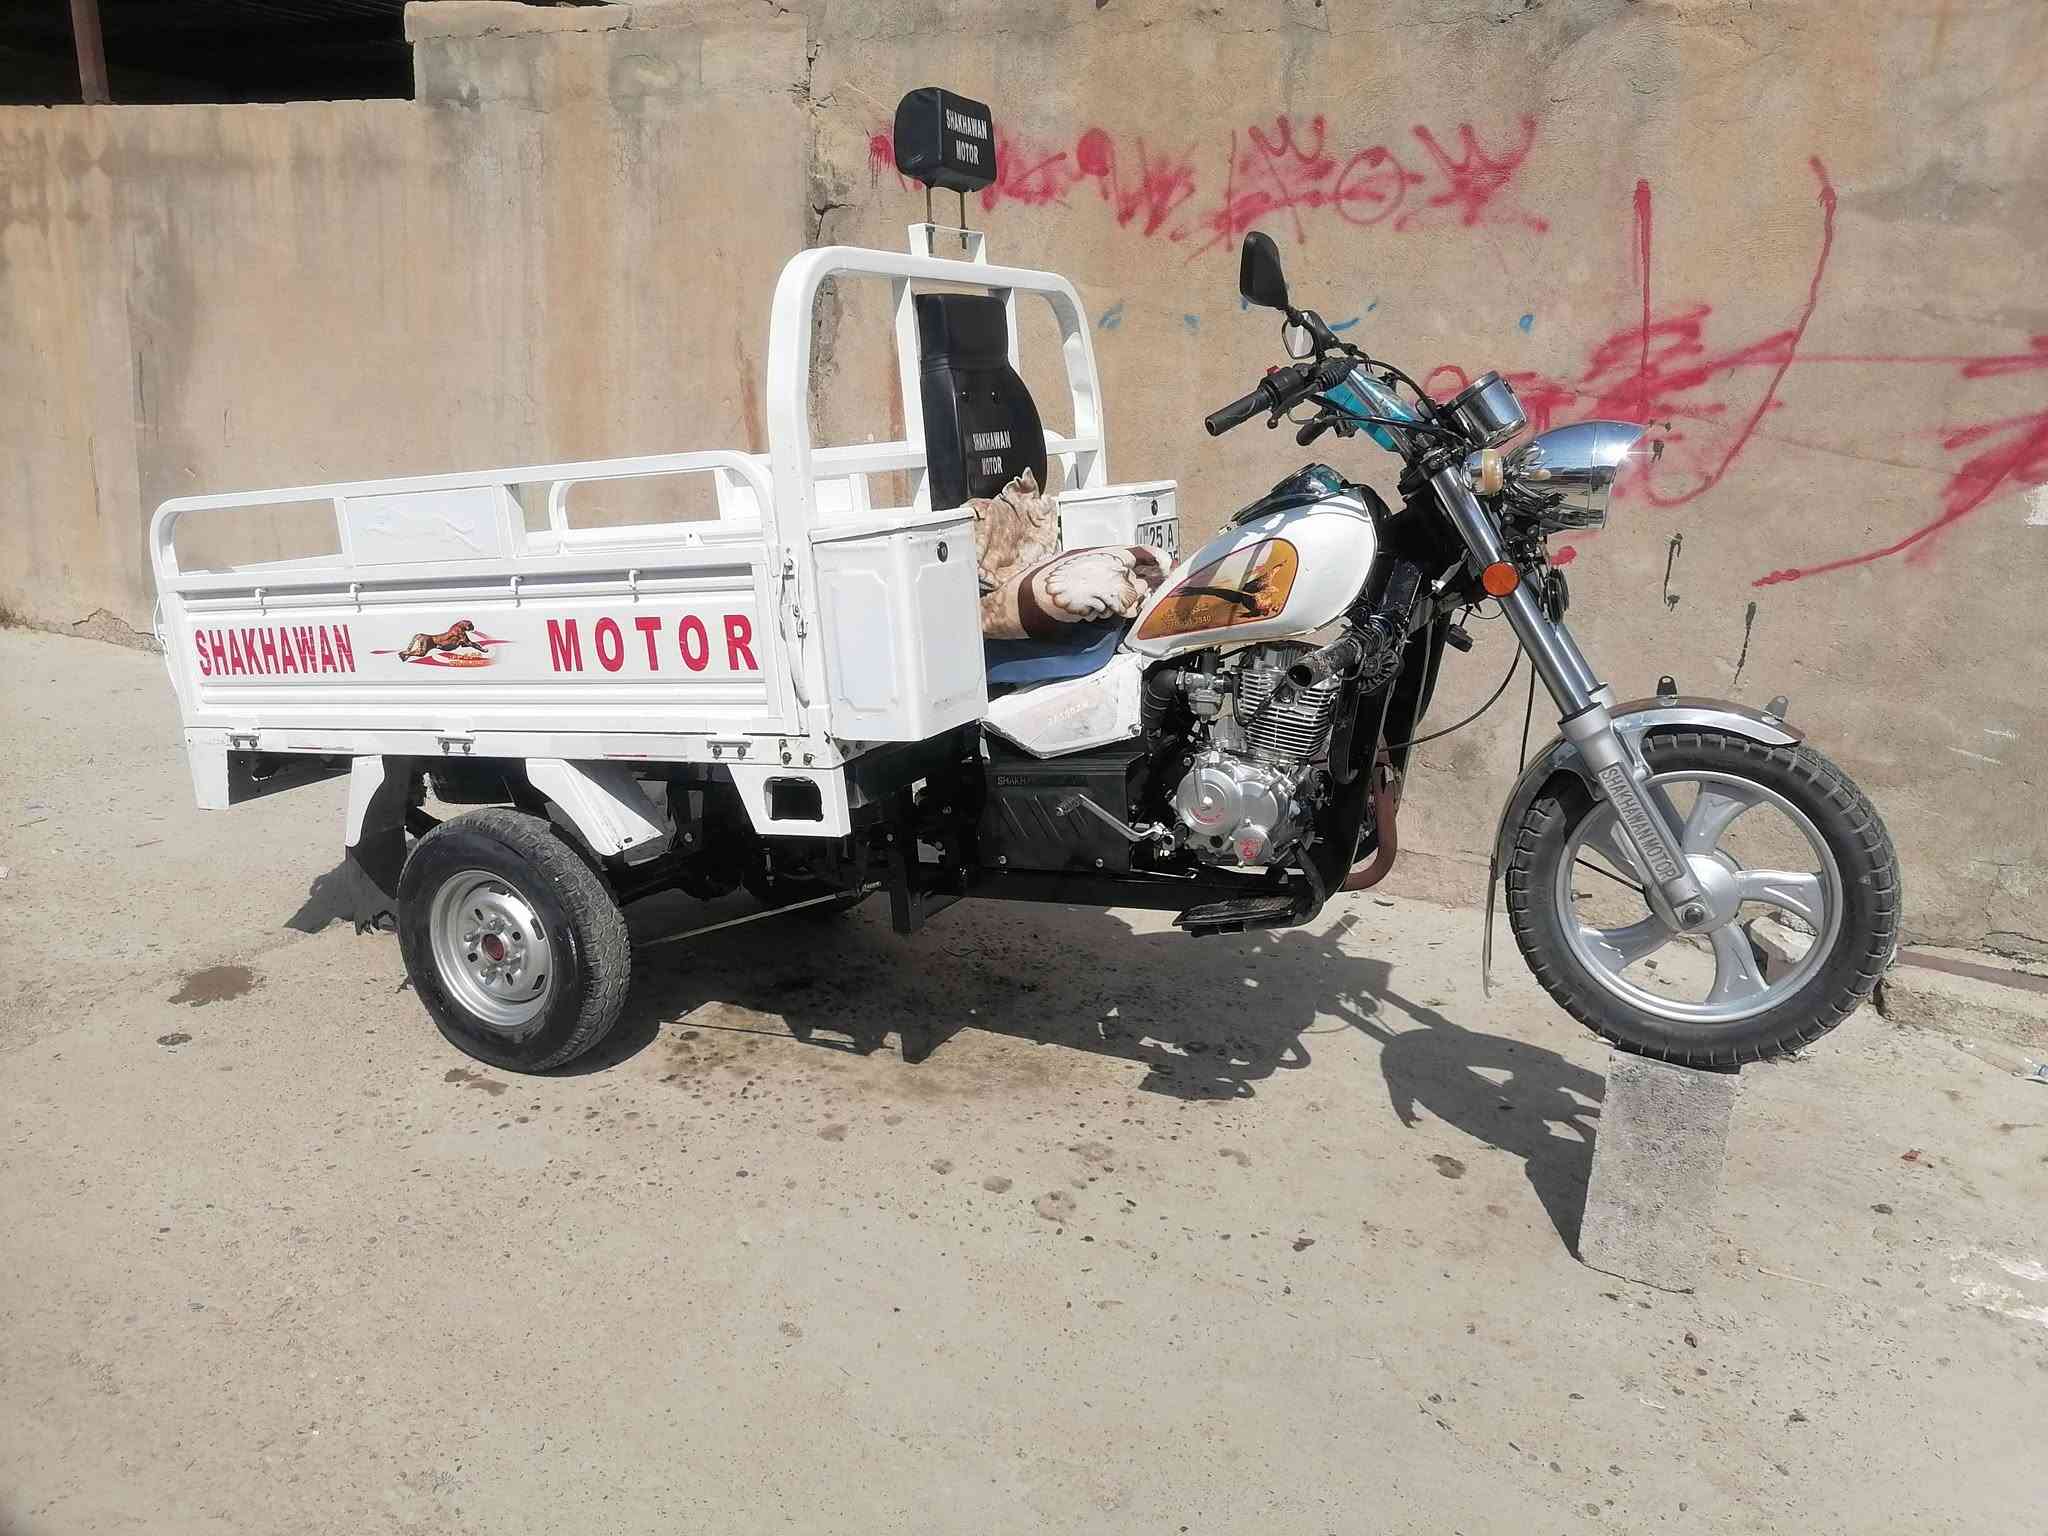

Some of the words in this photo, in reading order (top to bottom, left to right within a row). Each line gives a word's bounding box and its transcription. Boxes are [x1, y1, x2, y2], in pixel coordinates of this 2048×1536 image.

[946, 109, 988, 139] SHAKHAWAN
[955, 140, 979, 165] MOTOR
[981, 456, 1003, 476] MOTOR
[194, 623, 357, 676] SHAKHAWAN
[546, 614, 760, 672] MOTOR
[1601, 767, 1654, 840] SHAKHAWAN
[1641, 837, 1677, 880] MOTOR
